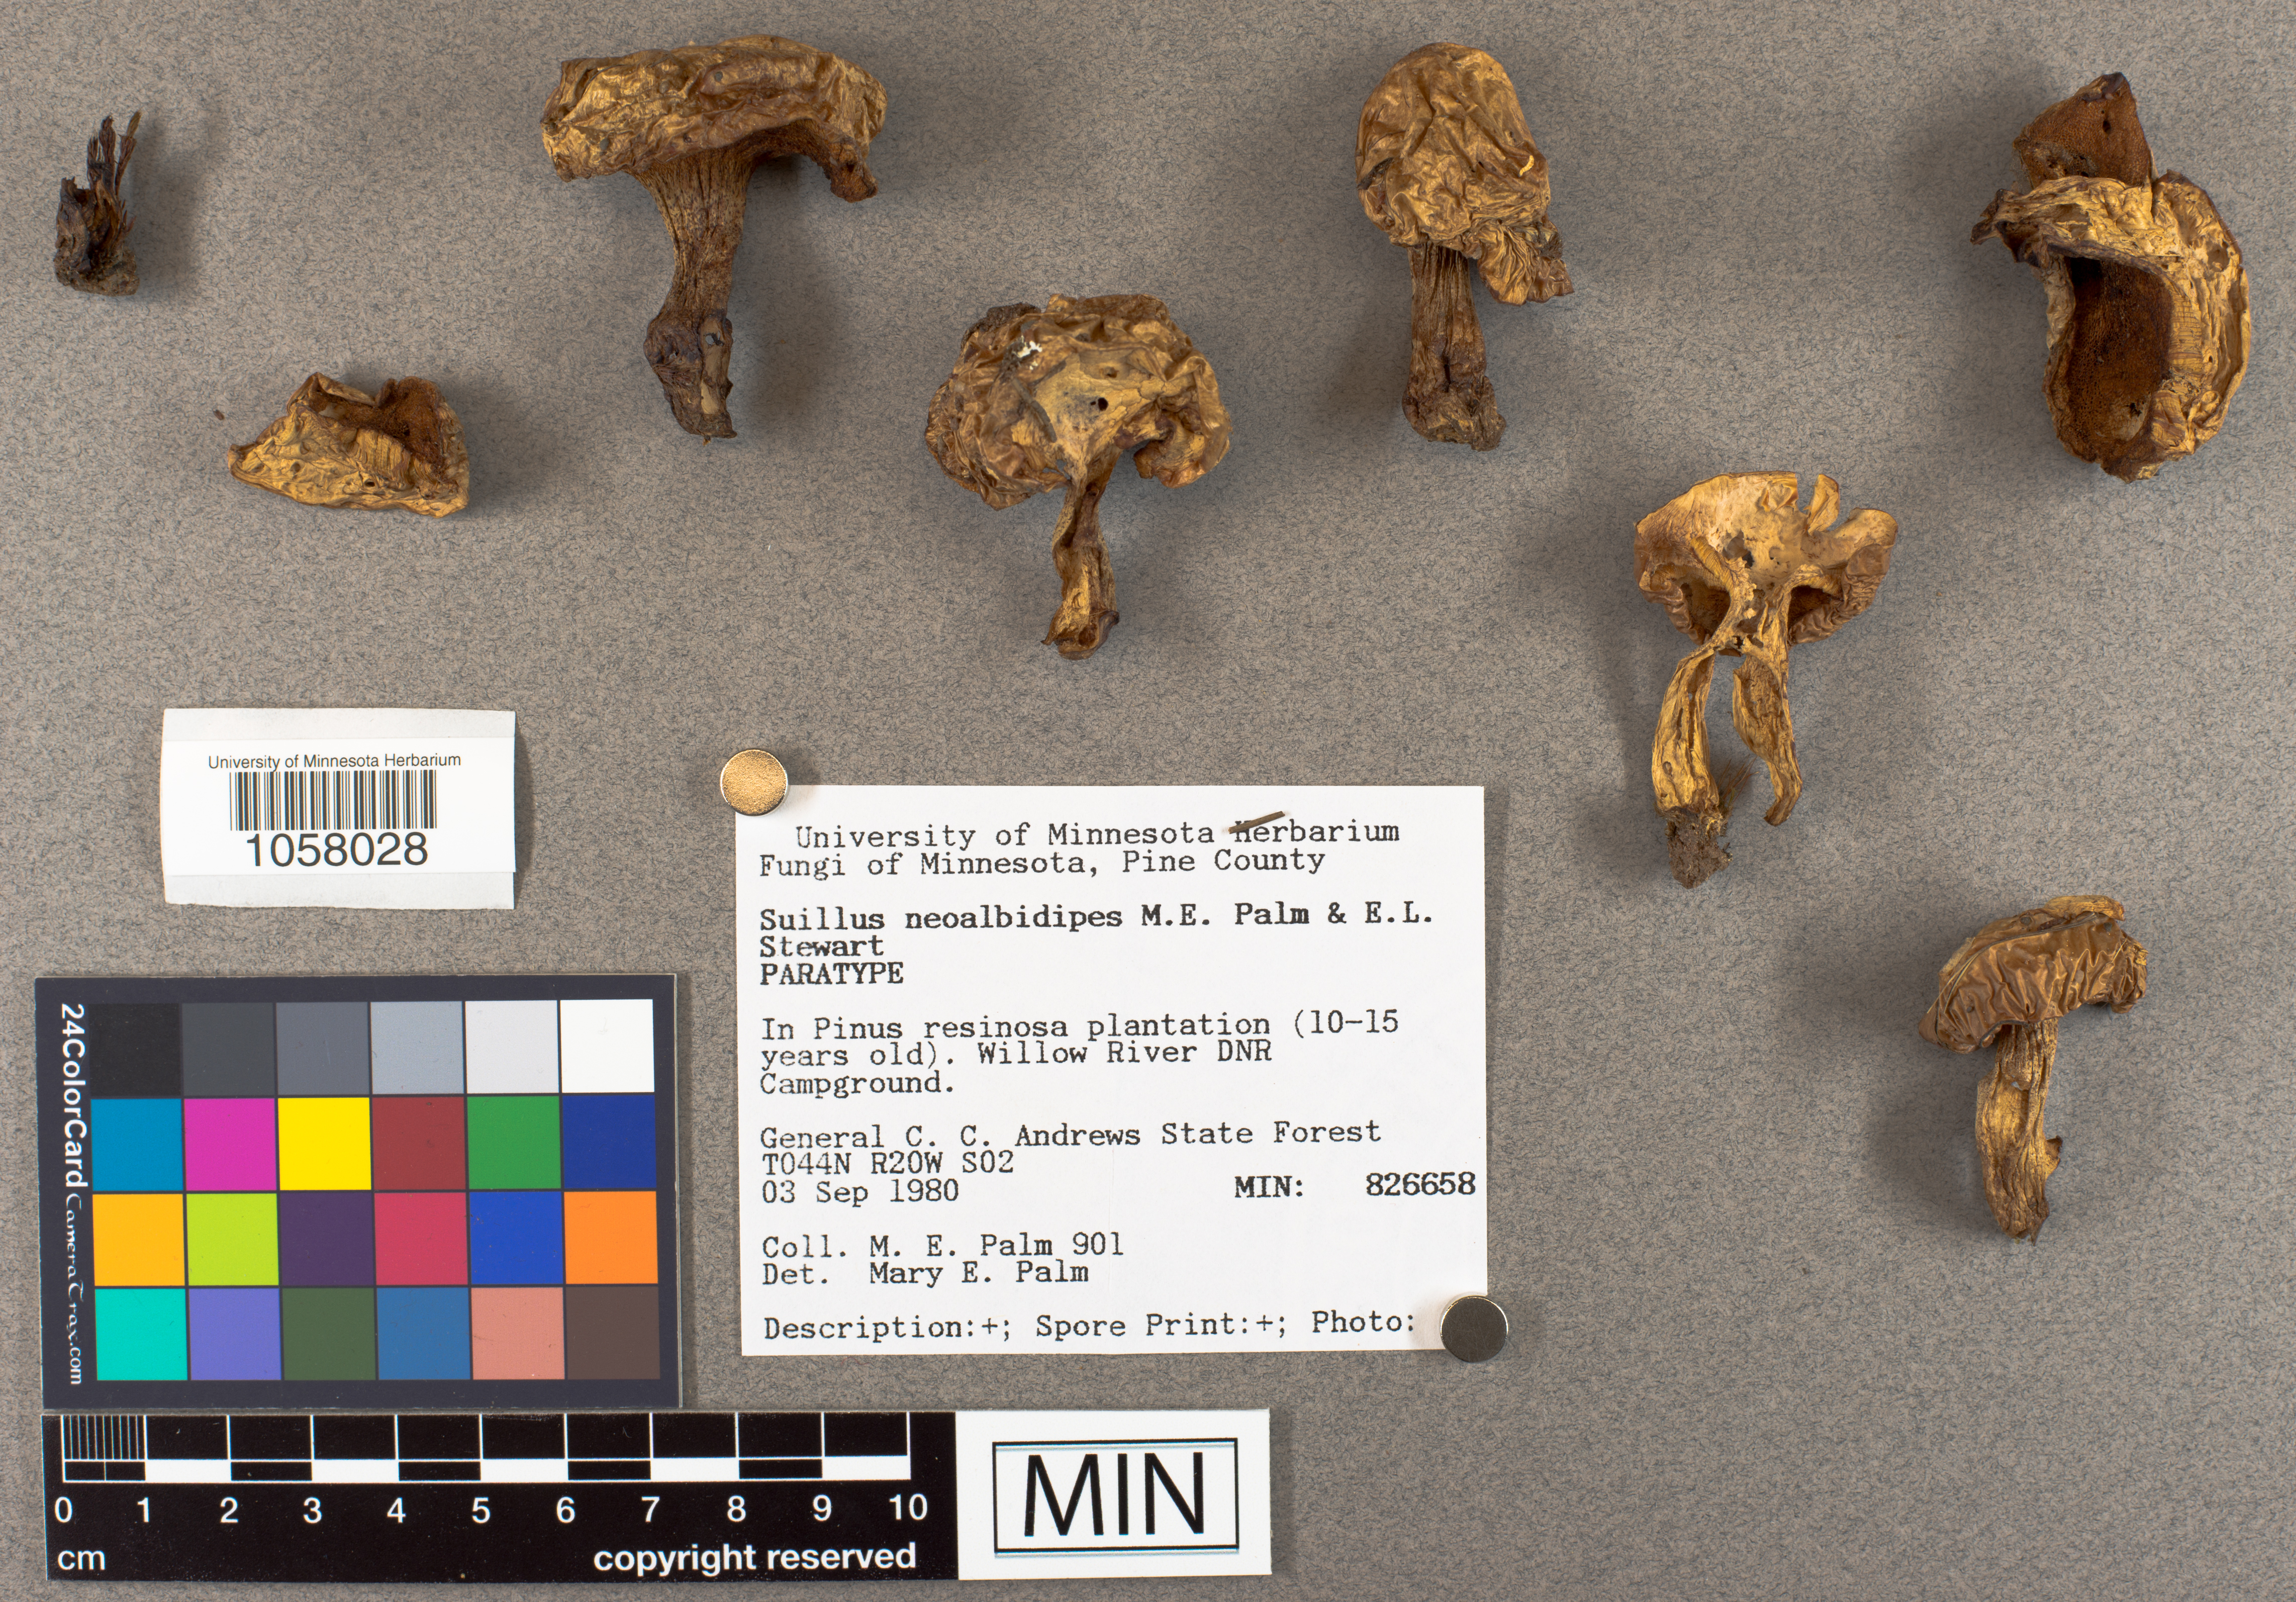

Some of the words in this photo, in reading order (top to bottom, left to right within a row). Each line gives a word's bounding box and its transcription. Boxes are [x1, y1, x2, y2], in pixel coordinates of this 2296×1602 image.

[209, 756, 280, 772] University
[285, 754, 299, 768] of
[304, 754, 379, 768] Minnesota
[385, 753, 461, 767] Herbarium
[247, 831, 428, 867] 1058028
[796, 824, 976, 852] University
[996, 821, 1031, 846] of
[1048, 821, 1215, 845] Minnesota
[759, 853, 845, 881] Fungi
[867, 852, 903, 875] of
[921, 852, 1097, 878] Minnesota,
[1122, 849, 1195, 873] Pine
[1214, 847, 1325, 875] County
[760, 906, 885, 931] Suillus
[905, 904, 1123, 932] neoalbidipes
[1141, 903, 1210, 926] M.E.
[1234, 901, 1310, 925] Palm
[1327, 902, 1347, 924] &
[1365, 901, 1431, 923] E.L.
[760, 934, 884, 958] Stewart
[760, 961, 904, 986] PARATYPE
[761, 1017, 794, 1041] In
[814, 1016, 903, 1040] Pinus
[924, 1015, 1069, 1039] resinosa
[1087, 1012, 1271, 1042] plantation
[1295, 1008, 1398, 1039] (10-15
[761, 1050, 848, 1071] years
[870, 1041, 953, 1069] old).
[977, 1040, 1088, 1064] Willow
[1107, 1040, 1197, 1063] River
[1217, 1039, 1272, 1062] DNR
[61, 1003, 88, 1187] 24ColorCard
[760, 1070, 953, 1099] Campground.
[760, 1124, 884, 1149] General
[906, 1125, 935, 1147] C.
[961, 1124, 990, 1147] C.
[1014, 1122, 1140, 1147] Andrews
[1162, 1121, 1253, 1145] State
[1274, 1119, 1381, 1143] Forest
[762, 1152, 852, 1175] T044N
[871, 1150, 943, 1174] R20W
[962, 1150, 1014, 1173] S02
[762, 1180, 795, 1203] 03
[816, 1181, 869, 1208] Sep
[890, 1178, 959, 1202] 1980
[1234, 1175, 1303, 1198] MIN:
[1366, 1171, 1476, 1196] 826658
[762, 1234, 846, 1259] Coll.
[870, 1235, 900, 1257] M.
[926, 1234, 955, 1257] E.
[981, 1232, 1053, 1256] Palm
[1073, 1232, 1124, 1256] 901
[66, 1193, 83, 1384] CameraTrax.com
[762, 1263, 827, 1285] Det.
[870, 1261, 943, 1288] Mary
[962, 1261, 991, 1283] E.
[1016, 1259, 1089, 1283] Palm
[764, 1314, 1009, 1343] Description:+;
[1036, 1314, 1126, 1342] Spore
[1146, 1312, 1285, 1338] Print:+;
[1312, 1309, 1413, 1333] Photo:
[54, 1496, 72, 1523] 0
[136, 1497, 149, 1523] 1
[220, 1497, 238, 1523] 2
[304, 1497, 322, 1524] 3
[387, 1497, 406, 1523] 4
[472, 1497, 490, 1524] 5
[556, 1496, 575, 1523] 6
[641, 1496, 659, 1522] 7
[727, 1495, 746, 1522] 8
[813, 1494, 831, 1521] 9
[890, 1493, 927, 1520] 10
[1024, 1452, 1204, 1537] MIN
[58, 1550, 105, 1570] cm
[594, 1544, 756, 1577] copyright
[768, 1542, 916, 1569] reserved
